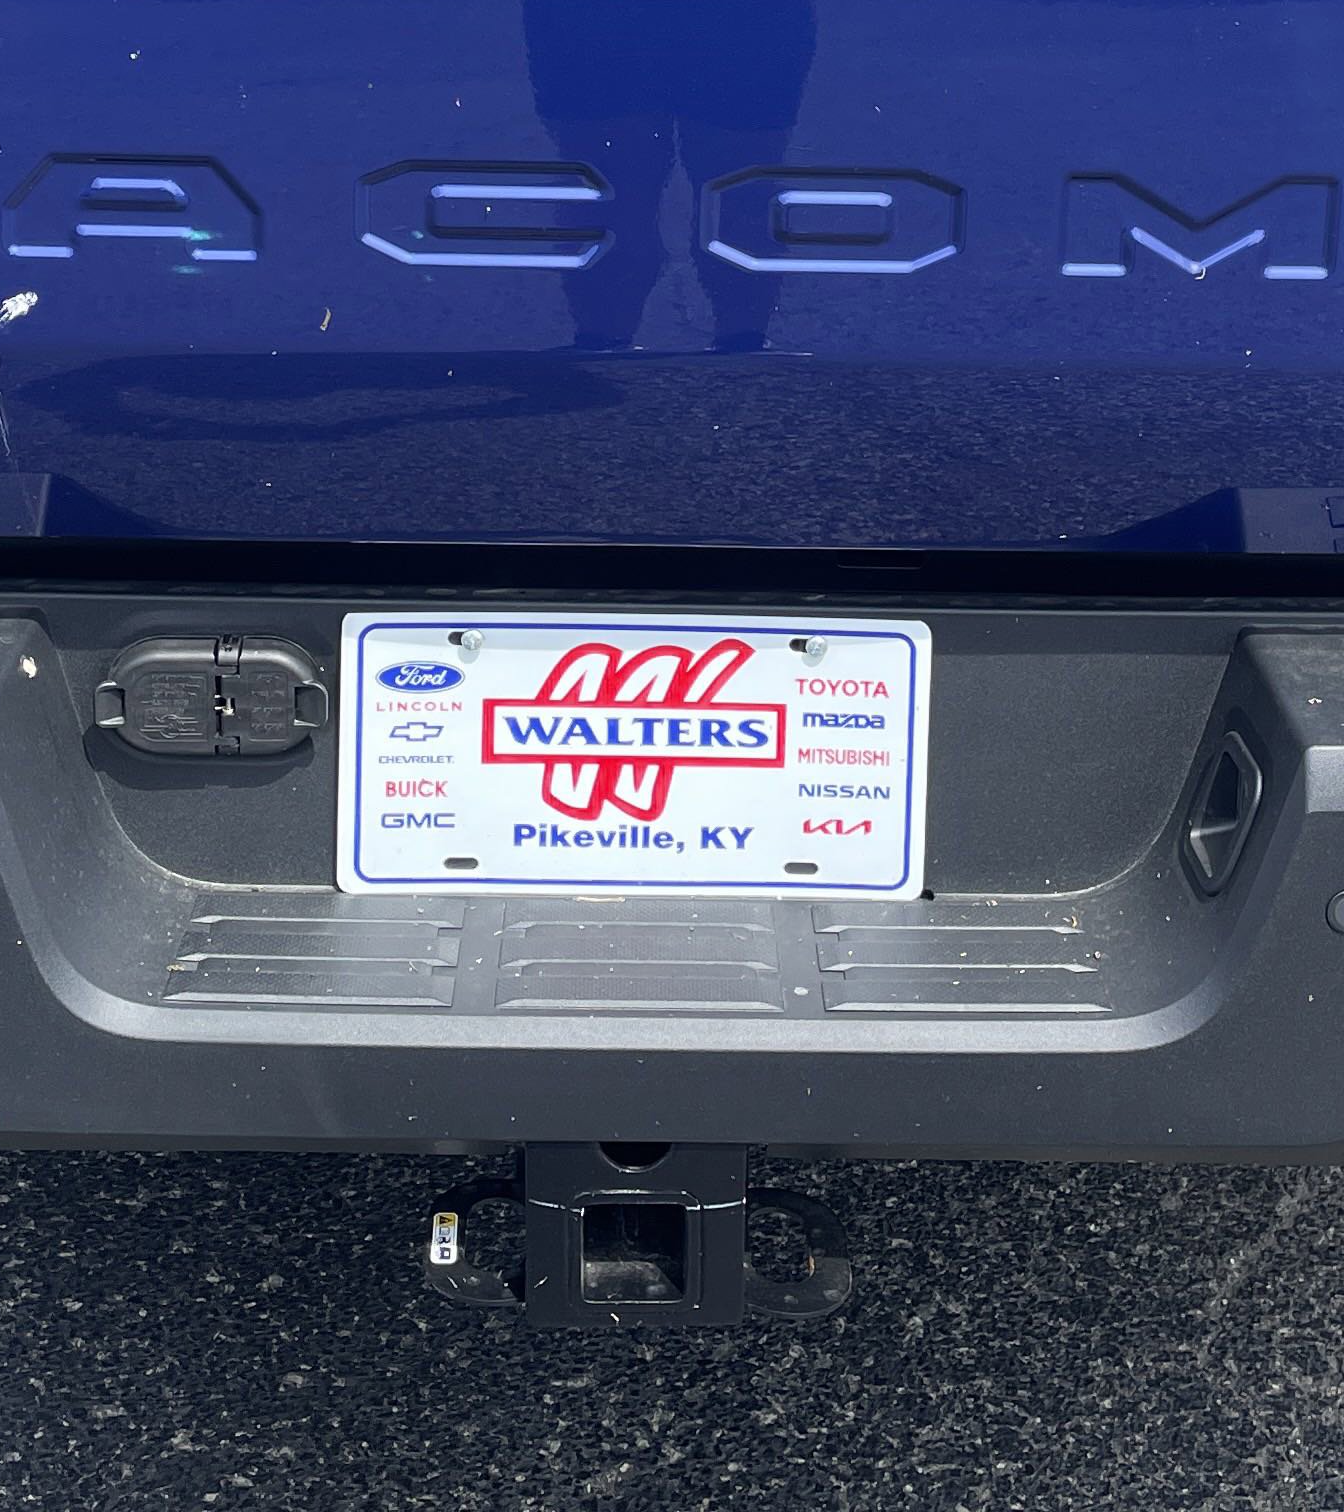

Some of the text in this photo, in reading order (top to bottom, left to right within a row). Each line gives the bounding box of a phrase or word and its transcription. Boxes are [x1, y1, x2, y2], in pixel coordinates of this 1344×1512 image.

[394, 664, 448, 686] Ford
[795, 678, 889, 699] TOYOTA
[376, 701, 463, 712] LINCOLN
[502, 715, 770, 749] WALTERS
[378, 755, 454, 764] CHEVROLET
[798, 748, 891, 767] MITSUBISHI
[385, 778, 449, 798] BUICK
[798, 783, 891, 800] NISSAN
[381, 812, 456, 829] GMC
[802, 818, 873, 836] KIA
[513, 823, 755, 854] Pikeville, KY
